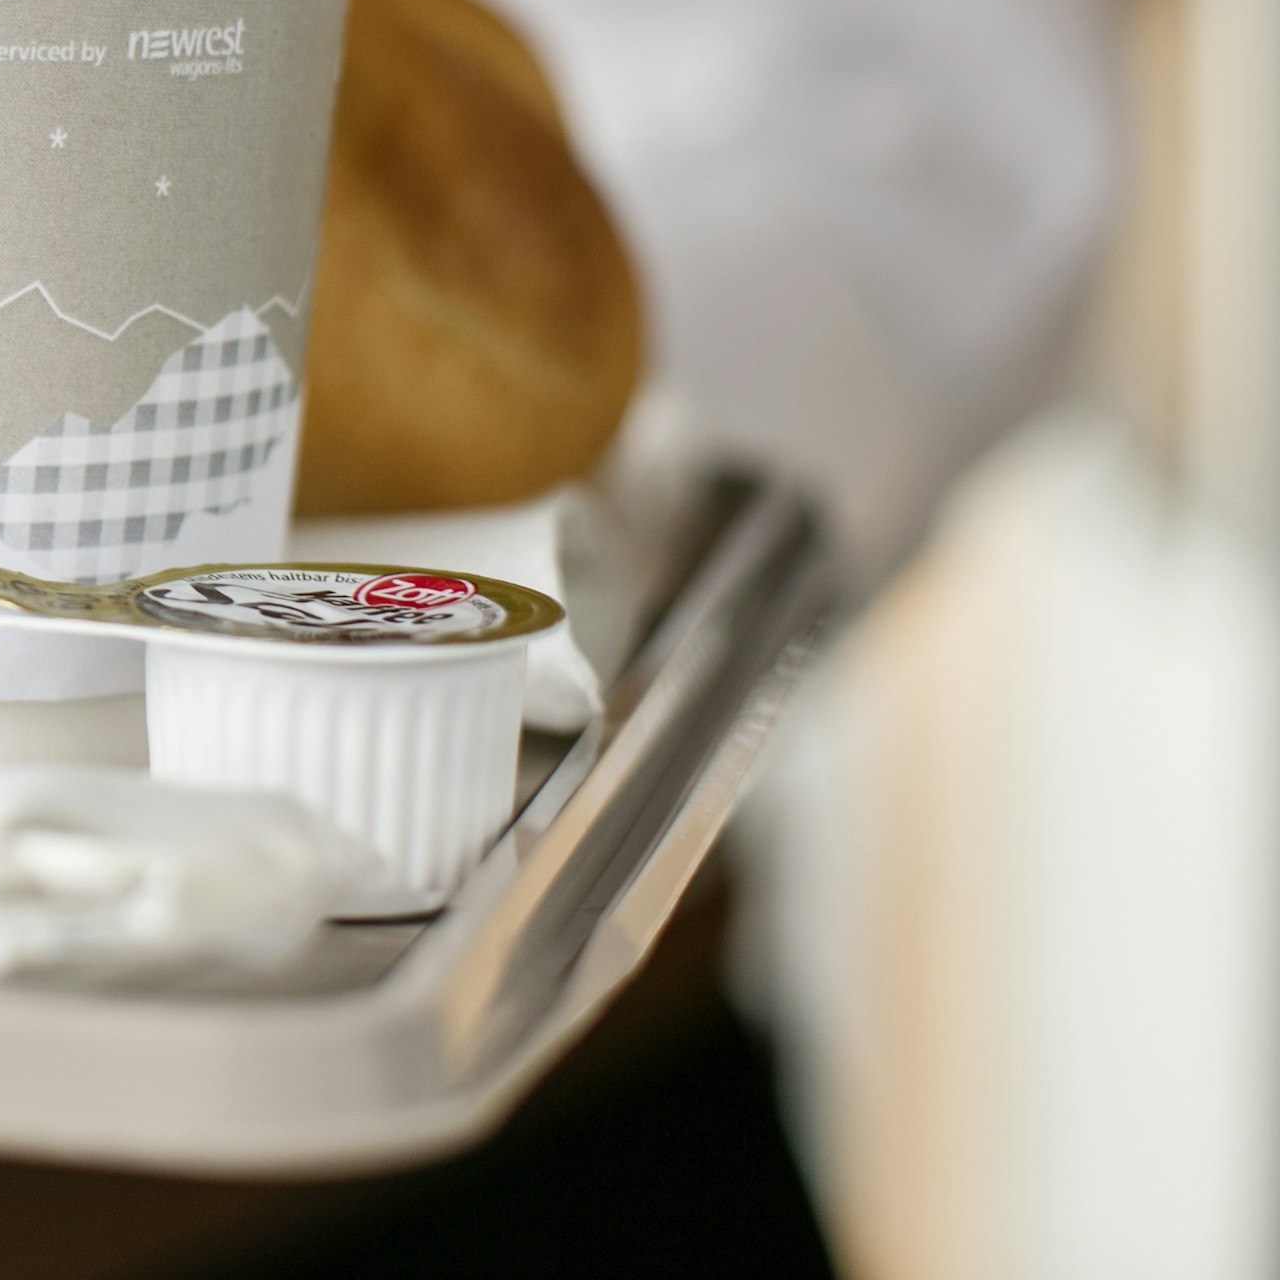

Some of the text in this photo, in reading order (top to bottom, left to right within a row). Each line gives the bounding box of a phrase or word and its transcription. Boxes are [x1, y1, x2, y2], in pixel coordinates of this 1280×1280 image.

[80, 41, 108, 67] by
[268, 571, 330, 582] haltbar
[290, 589, 454, 625] Kaffee
